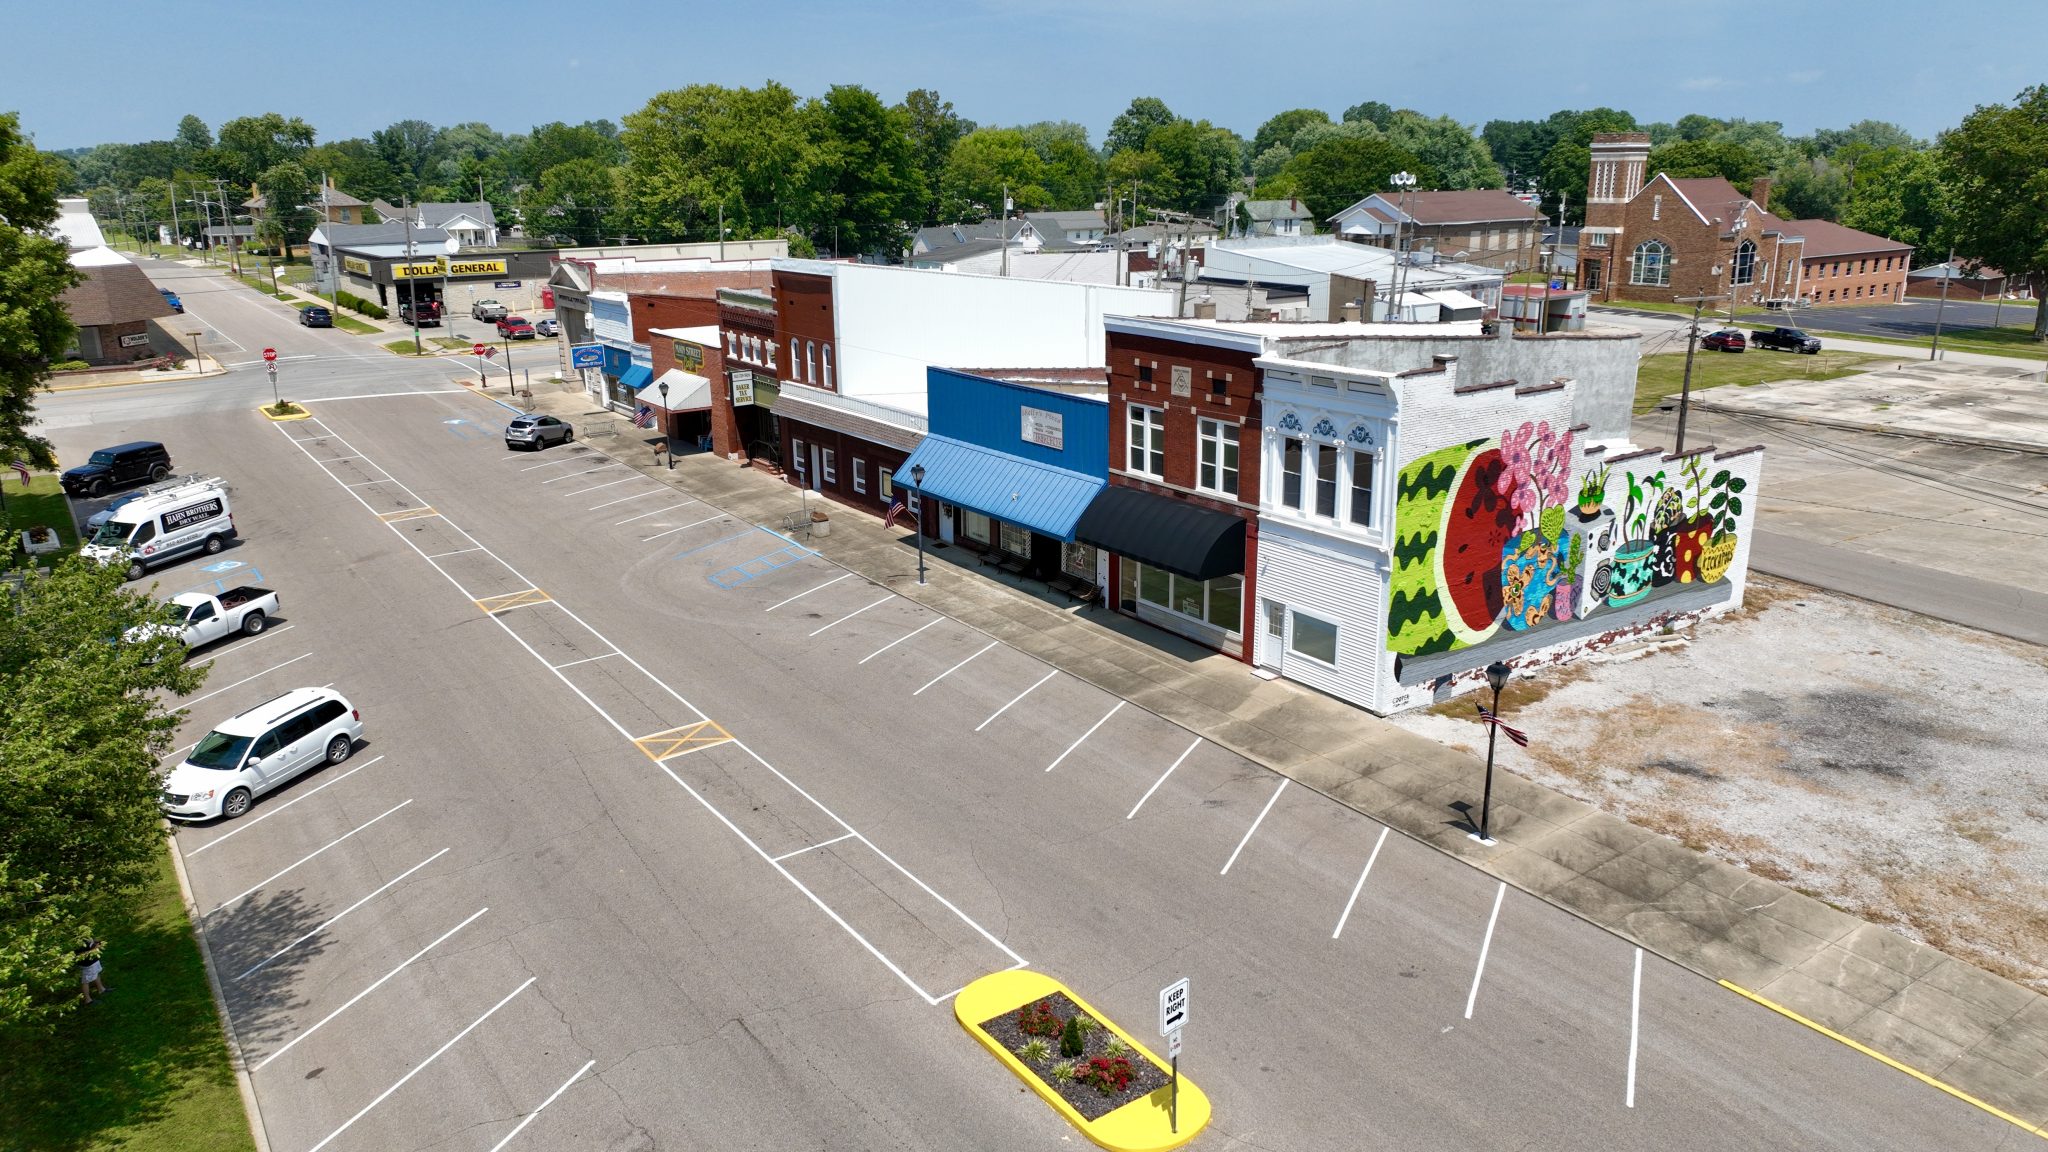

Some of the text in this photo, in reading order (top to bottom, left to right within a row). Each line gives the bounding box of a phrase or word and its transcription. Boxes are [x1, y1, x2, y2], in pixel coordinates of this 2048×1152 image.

[403, 265, 439, 276] DOLLA
[451, 263, 500, 273] GENERAL
[685, 346, 702, 358] STREET
[165, 502, 218, 526] HAHN BROTHERS
[1168, 988, 1184, 1003] KEEP
[1166, 998, 1185, 1016] RIGHT
